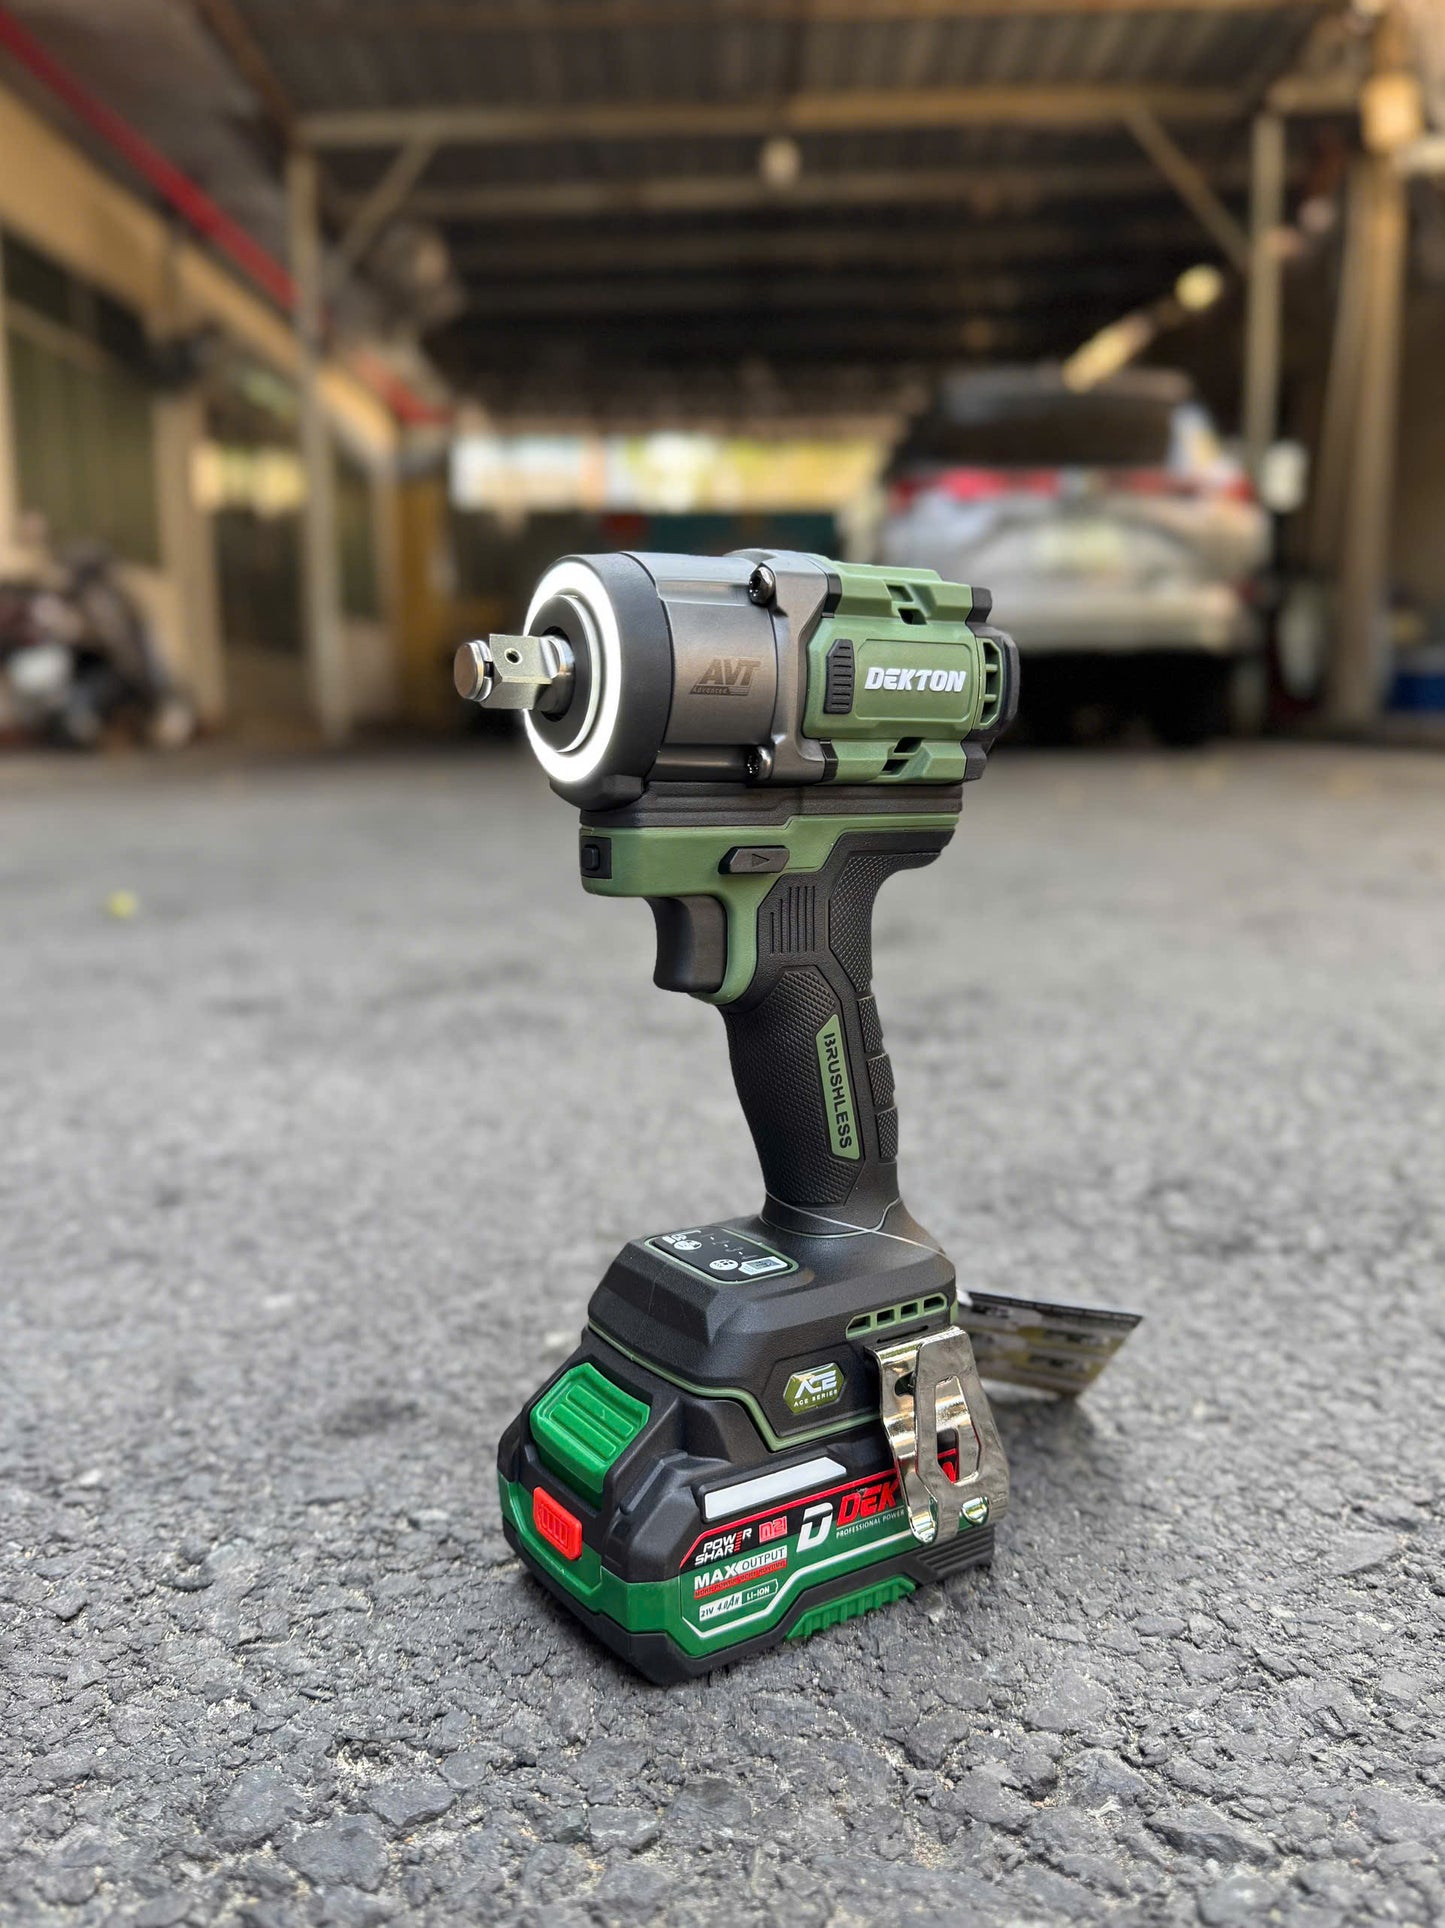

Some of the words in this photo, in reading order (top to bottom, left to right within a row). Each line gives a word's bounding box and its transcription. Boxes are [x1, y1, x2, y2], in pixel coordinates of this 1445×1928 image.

[700, 658, 761, 686] AVT
[864, 666, 967, 693] DEKTON
[822, 1032, 853, 1150] BRUSHLESS
[793, 1398, 809, 1408] ACE
[811, 1389, 838, 1402] SERIES
[794, 1369, 838, 1399] ACE
[836, 1517, 880, 1539] PROFESSIONAL
[882, 1508, 905, 1526] POWER
[694, 1562, 738, 1591] MAX
[741, 1547, 785, 1571] OUTPUT
[700, 1606, 714, 1618] 21V
[746, 1586, 770, 1601] LI-ION
